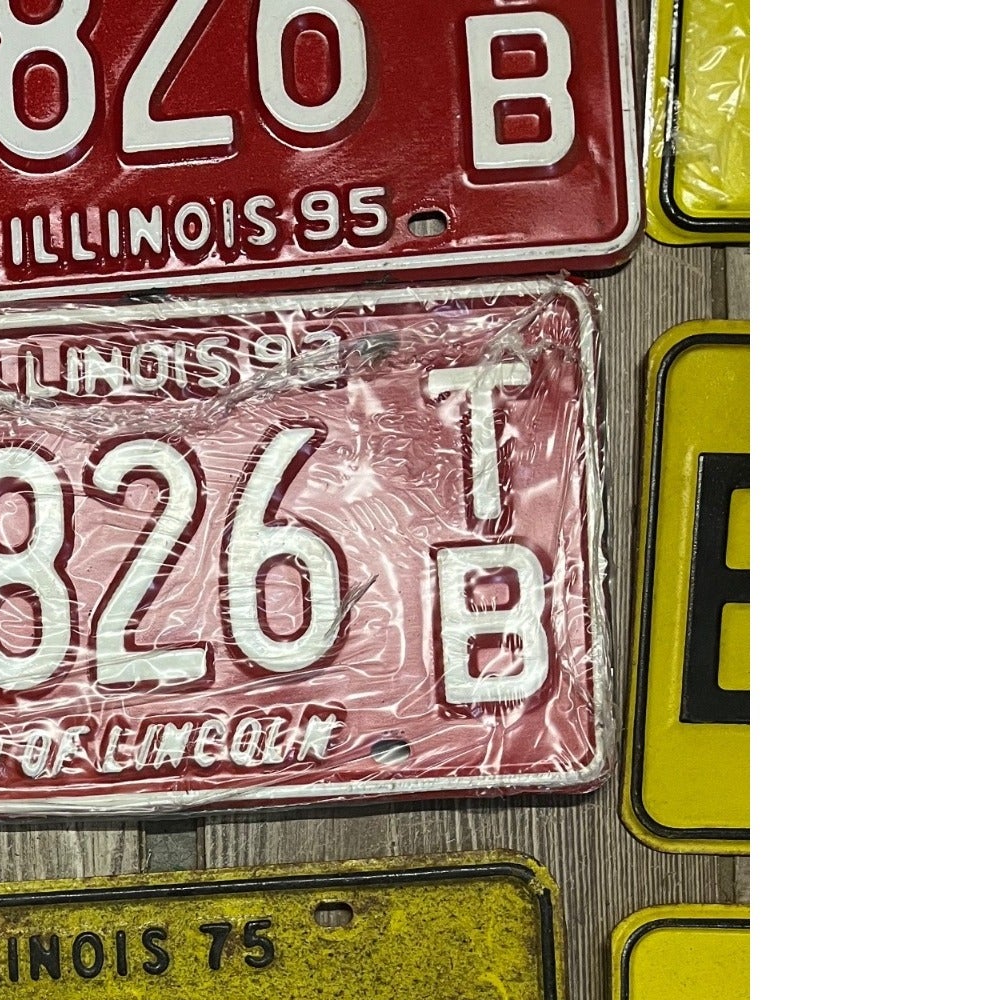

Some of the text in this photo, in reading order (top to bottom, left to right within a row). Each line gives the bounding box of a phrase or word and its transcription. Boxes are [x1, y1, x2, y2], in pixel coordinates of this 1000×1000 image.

[10, 195, 277, 265] ILLINOIS
[301, 186, 389, 241] 95
[21, 725, 91, 778] OF
[101, 713, 337, 774] LINCOLN
[200, 920, 275, 971] 75
